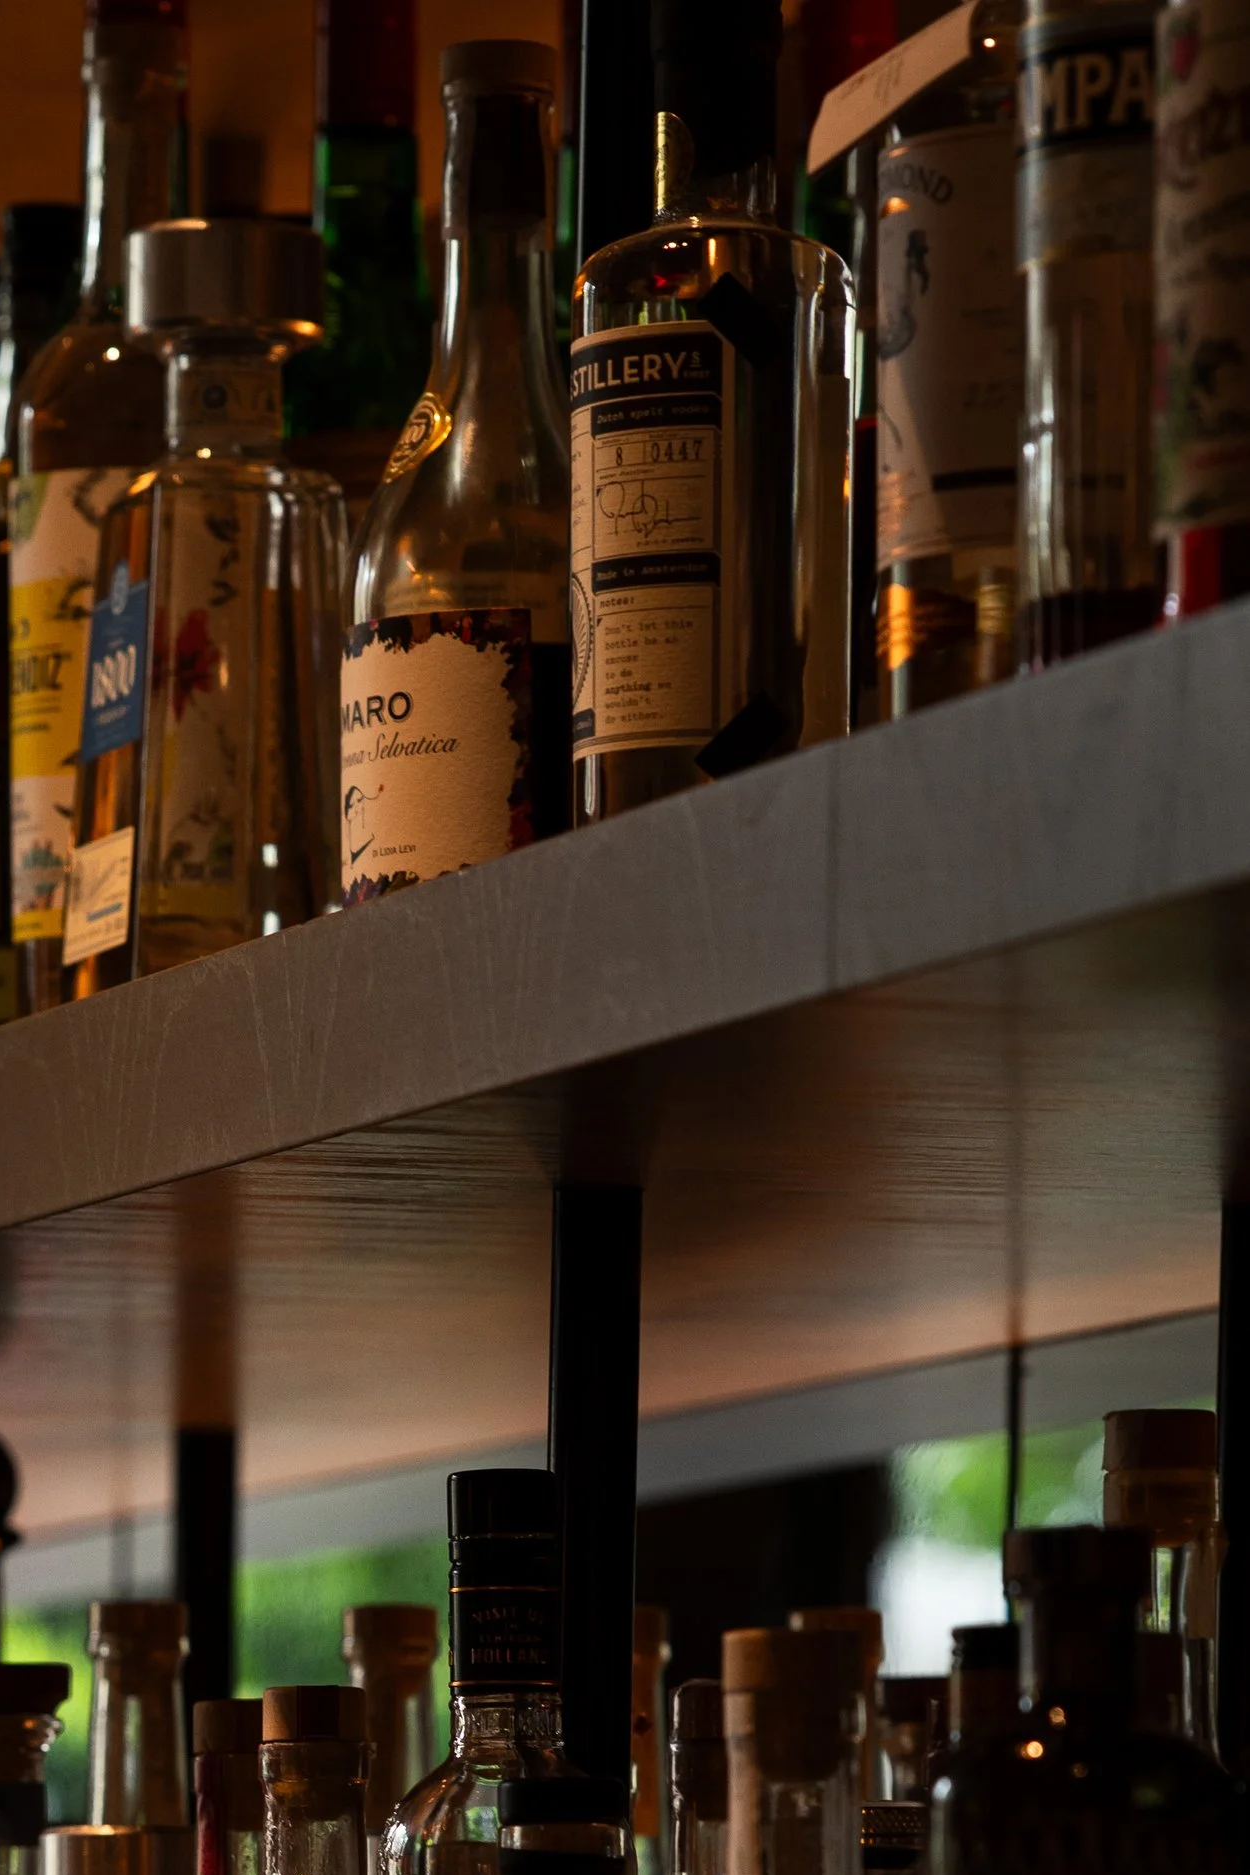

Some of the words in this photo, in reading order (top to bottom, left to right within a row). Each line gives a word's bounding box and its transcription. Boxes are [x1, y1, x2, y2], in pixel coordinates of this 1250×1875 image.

[571, 351, 687, 398] STILLERY
[630, 405, 664, 421] spelt
[615, 446, 623, 467] 8
[650, 440, 703, 464] 0447
[622, 567, 636, 578] in
[639, 621, 658, 631] let
[664, 619, 693, 630] this
[644, 636, 658, 646] be
[605, 671, 616, 680] to
[620, 668, 633, 678] do
[605, 681, 651, 695] anything
[368, 731, 459, 762] Selvatica
[471, 1606, 517, 1625] VISIT
